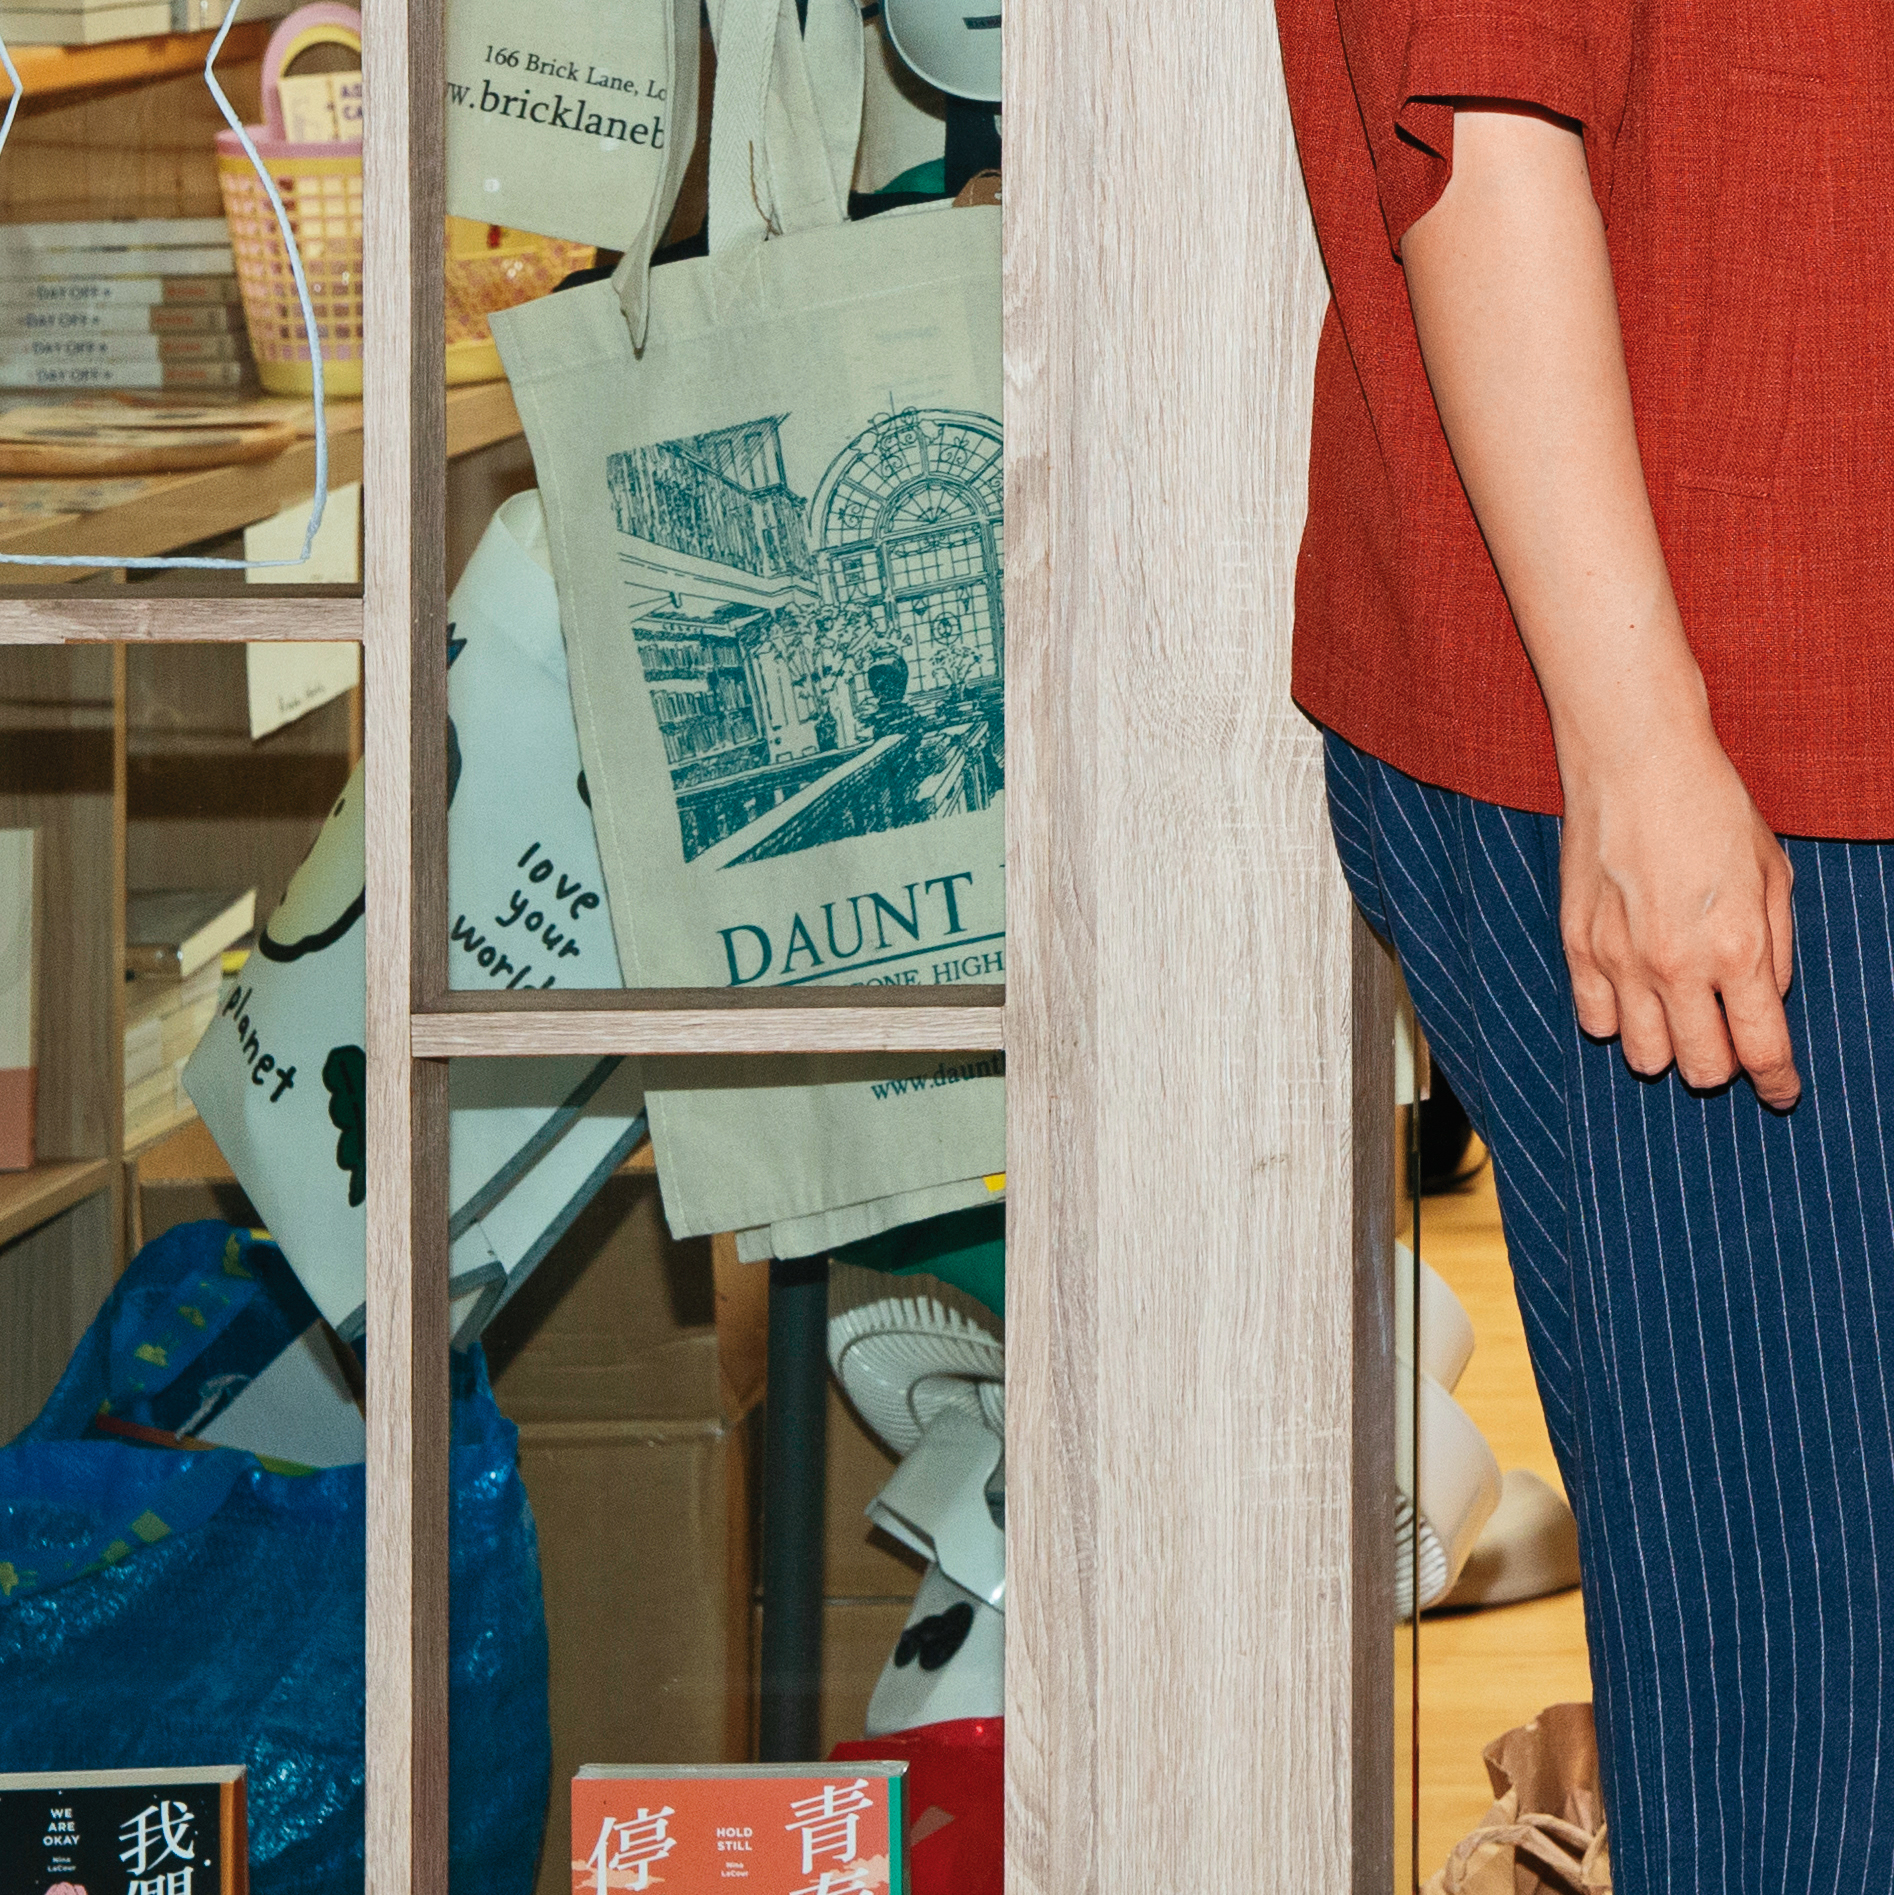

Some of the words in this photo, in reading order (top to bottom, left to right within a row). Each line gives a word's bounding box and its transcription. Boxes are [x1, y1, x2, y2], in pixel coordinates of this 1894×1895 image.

[485, 45, 520, 68] 166
[524, 53, 580, 82] Brick
[585, 66, 639, 96] Lane,
[518, 842, 600, 920] love
[495, 889, 580, 958] your
[716, 872, 974, 987] DAUNT
[221, 986, 297, 1103] planet
[48, 1821, 76, 1832] ARE
[50, 1808, 73, 1819] WE
[43, 1834, 80, 1846] OKAY
[716, 1827, 753, 1838] HOLD
[717, 1841, 752, 1851] STILL
